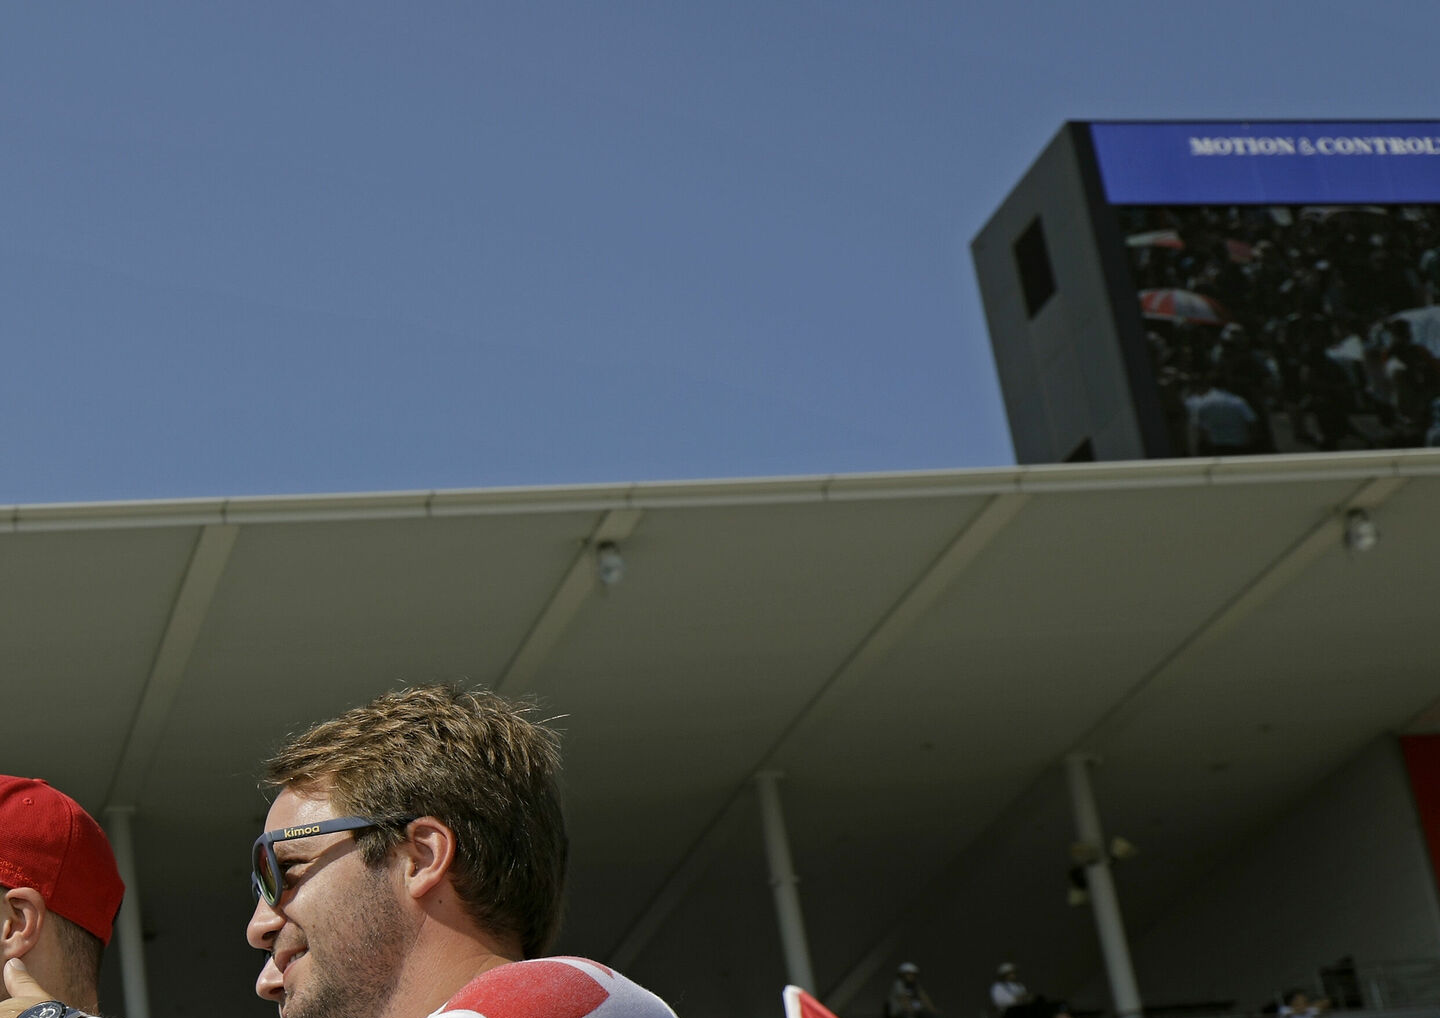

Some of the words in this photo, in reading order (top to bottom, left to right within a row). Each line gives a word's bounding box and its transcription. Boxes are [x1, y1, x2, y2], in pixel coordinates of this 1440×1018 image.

[1189, 136, 1296, 156] MOTION
[1298, 136, 1315, 156] &
[283, 824, 320, 840] kimoa
